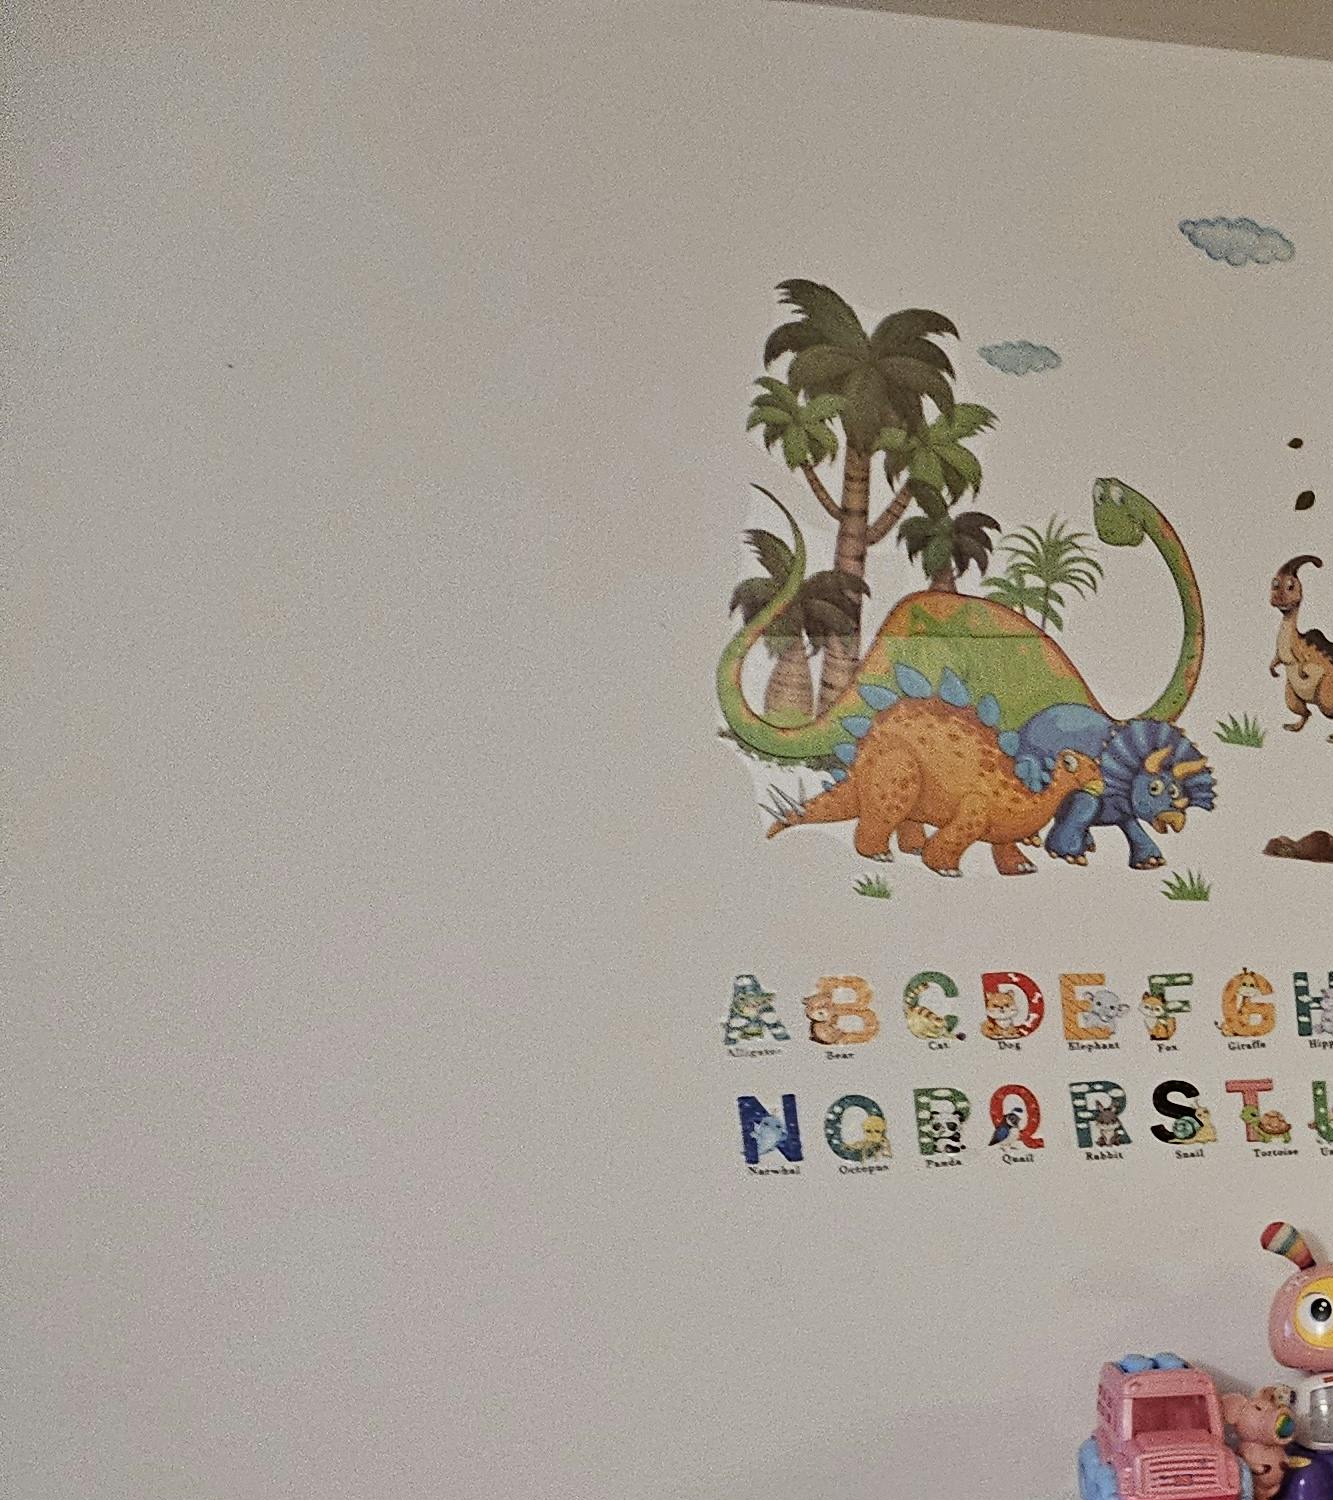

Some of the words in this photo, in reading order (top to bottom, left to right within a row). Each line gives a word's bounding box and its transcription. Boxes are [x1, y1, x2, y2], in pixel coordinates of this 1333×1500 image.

[724, 974, 790, 1045] A
[803, 975, 880, 1044] B
[903, 971, 959, 1040] C
[981, 972, 1045, 1040] D
[1059, 973, 1106, 1040] E
[1149, 973, 1193, 1040] F
[1223, 971, 1275, 1038] G
[824, 1051, 855, 1060] Bear
[927, 1041, 949, 1050] Cat
[1068, 1041, 1120, 1051] Elephant
[1157, 1043, 1178, 1052] Fox
[1227, 1041, 1267, 1050] Giraffe
[738, 1094, 803, 1163] N
[824, 1094, 885, 1161] O
[914, 1087, 972, 1154] P
[989, 1084, 1045, 1149] Q
[1069, 1081, 1132, 1148] R
[1152, 1080, 1200, 1144] S
[1227, 1079, 1273, 1142] T
[838, 1163, 889, 1175] Octopus
[925, 1158, 962, 1168] Panda
[1002, 1154, 1034, 1164] Quail
[1085, 1151, 1125, 1161] Rabbit
[1175, 1149, 1205, 1159] Snail
[1254, 1147, 1299, 1157] Tortoise
